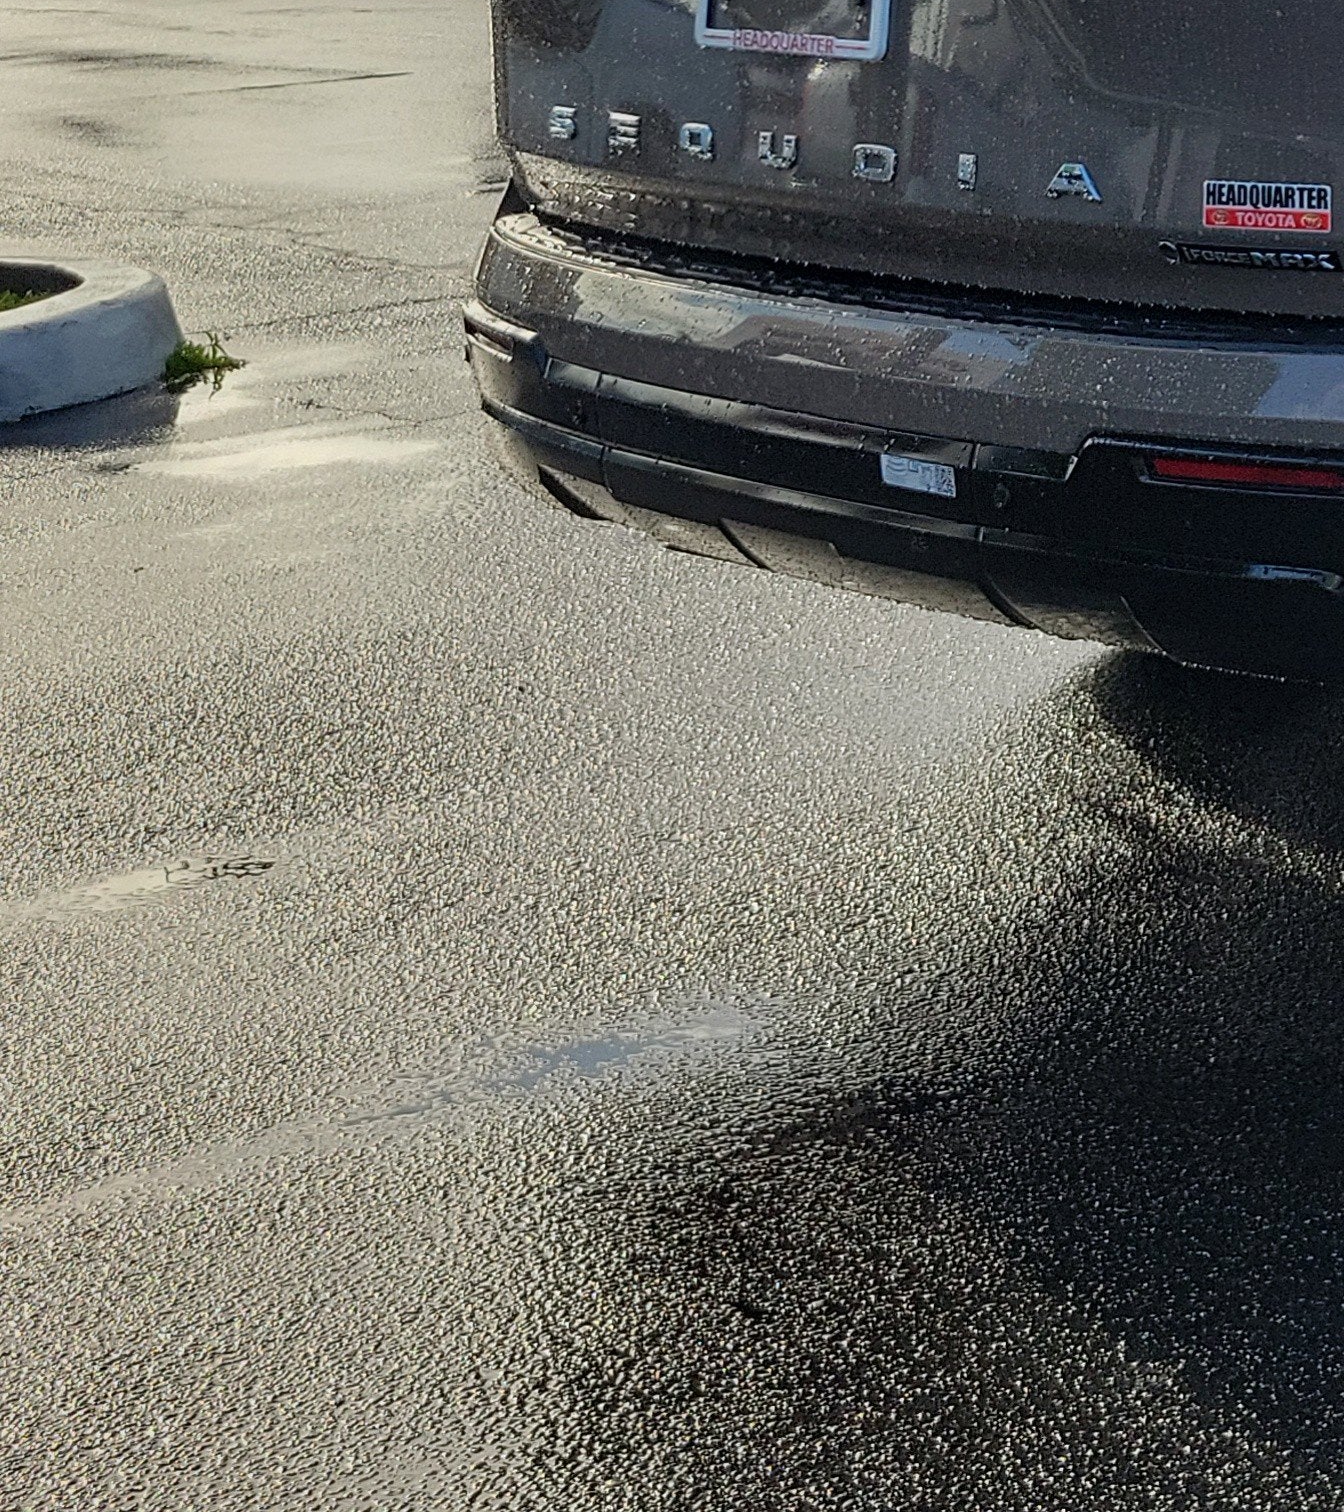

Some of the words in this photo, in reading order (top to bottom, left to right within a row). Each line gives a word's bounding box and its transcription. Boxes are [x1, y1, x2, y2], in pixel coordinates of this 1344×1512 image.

[732, 29, 835, 54] HEADQUARTER
[548, 104, 1102, 203] SEQUOIA
[1206, 182, 1329, 210] HEADQUARTER
[1235, 211, 1296, 228] TOYOTA
